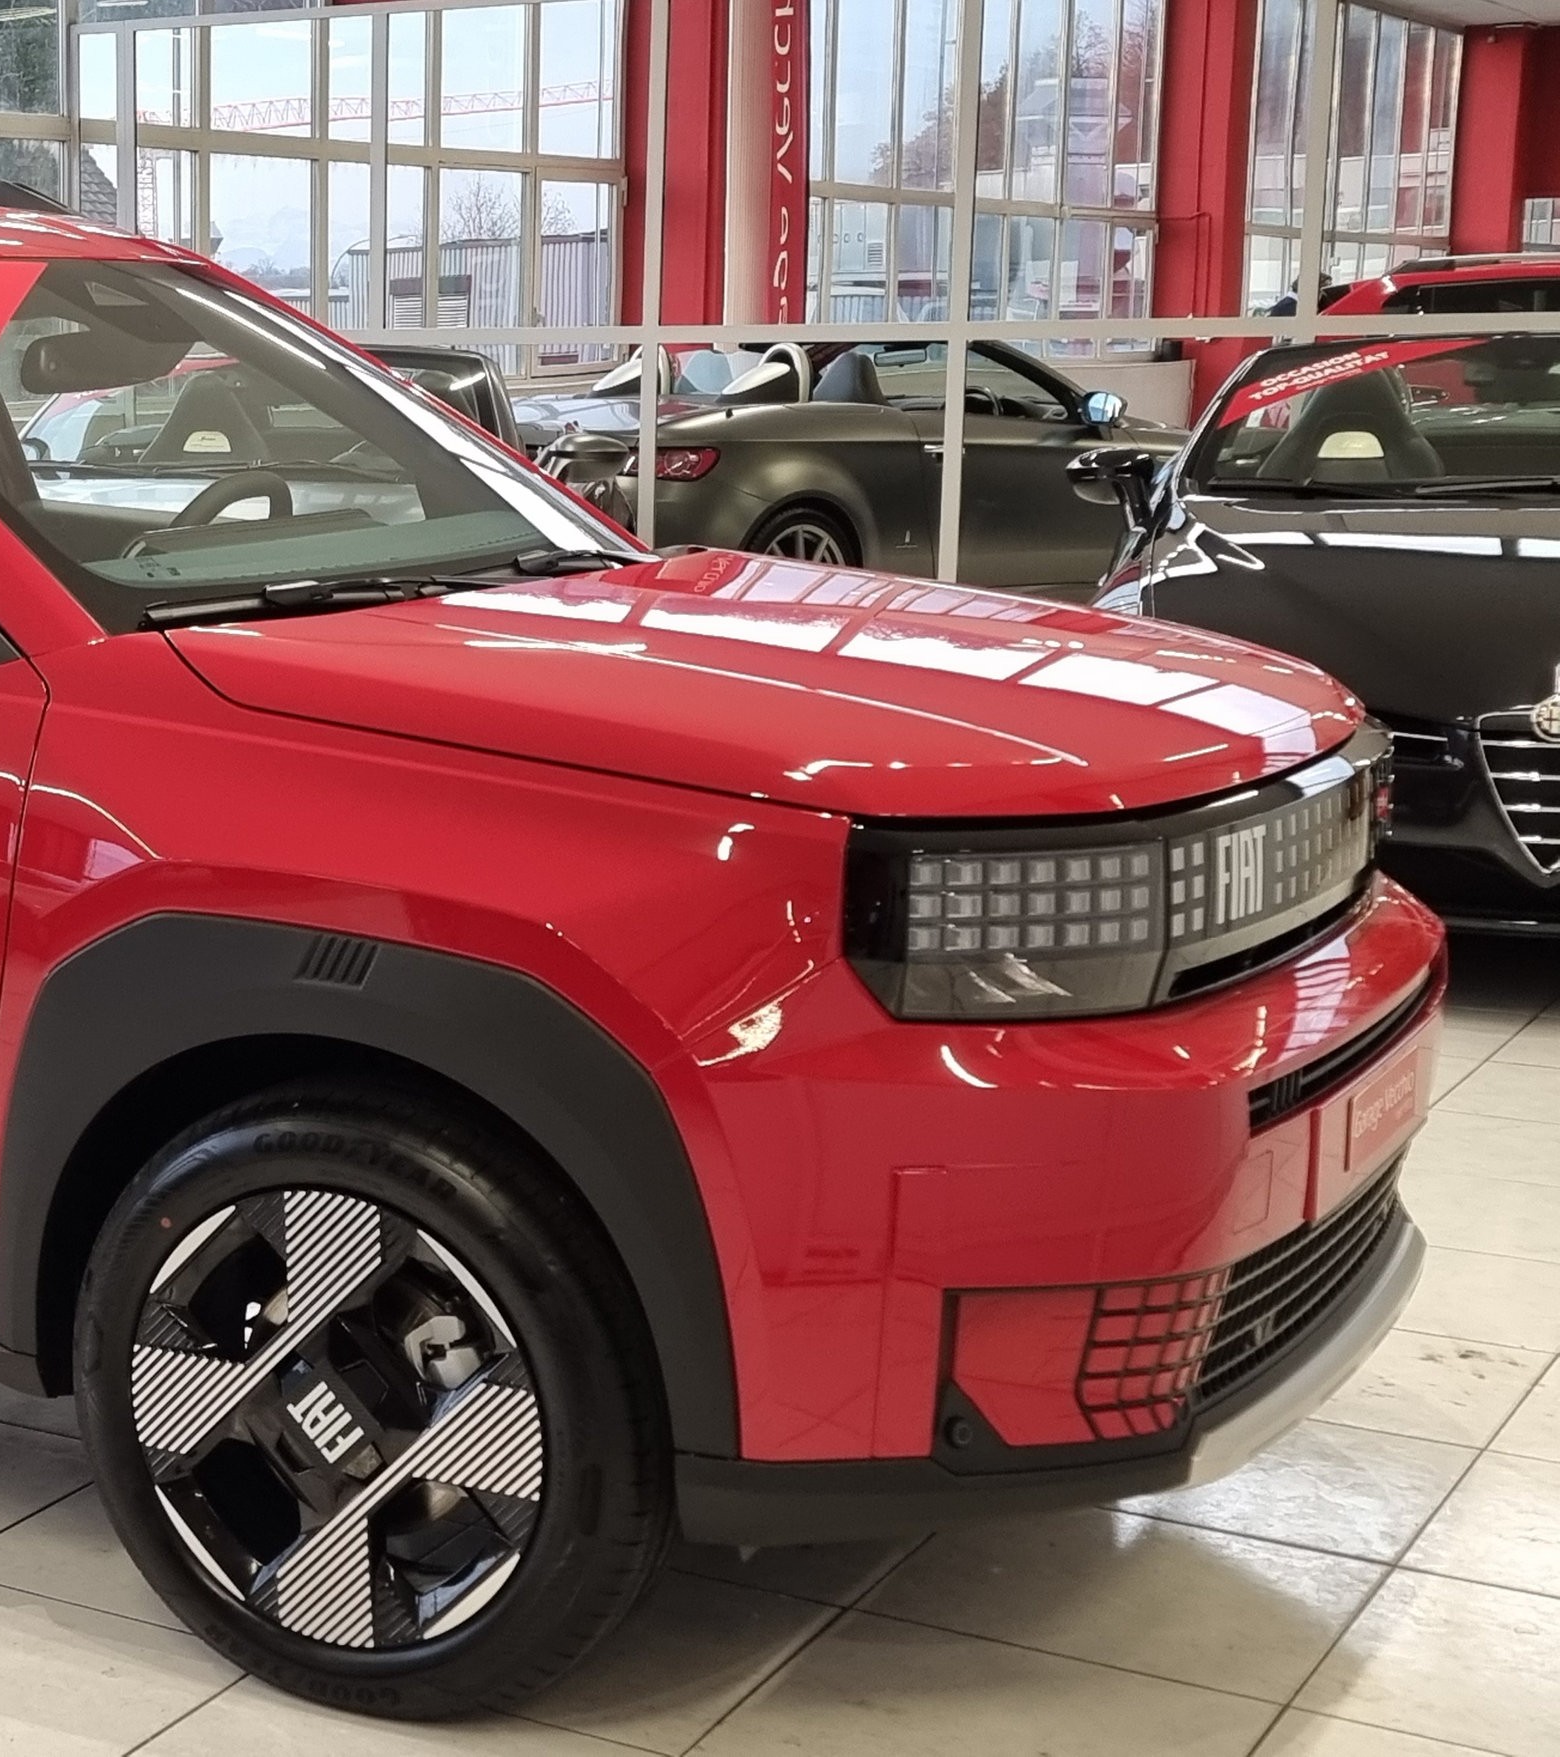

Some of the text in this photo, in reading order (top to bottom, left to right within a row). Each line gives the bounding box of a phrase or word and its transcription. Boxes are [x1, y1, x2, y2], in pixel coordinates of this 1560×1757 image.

[1259, 351, 1362, 387] OCCASION
[1214, 823, 1268, 926] FIAT
[286, 1380, 366, 1464] FIAT
